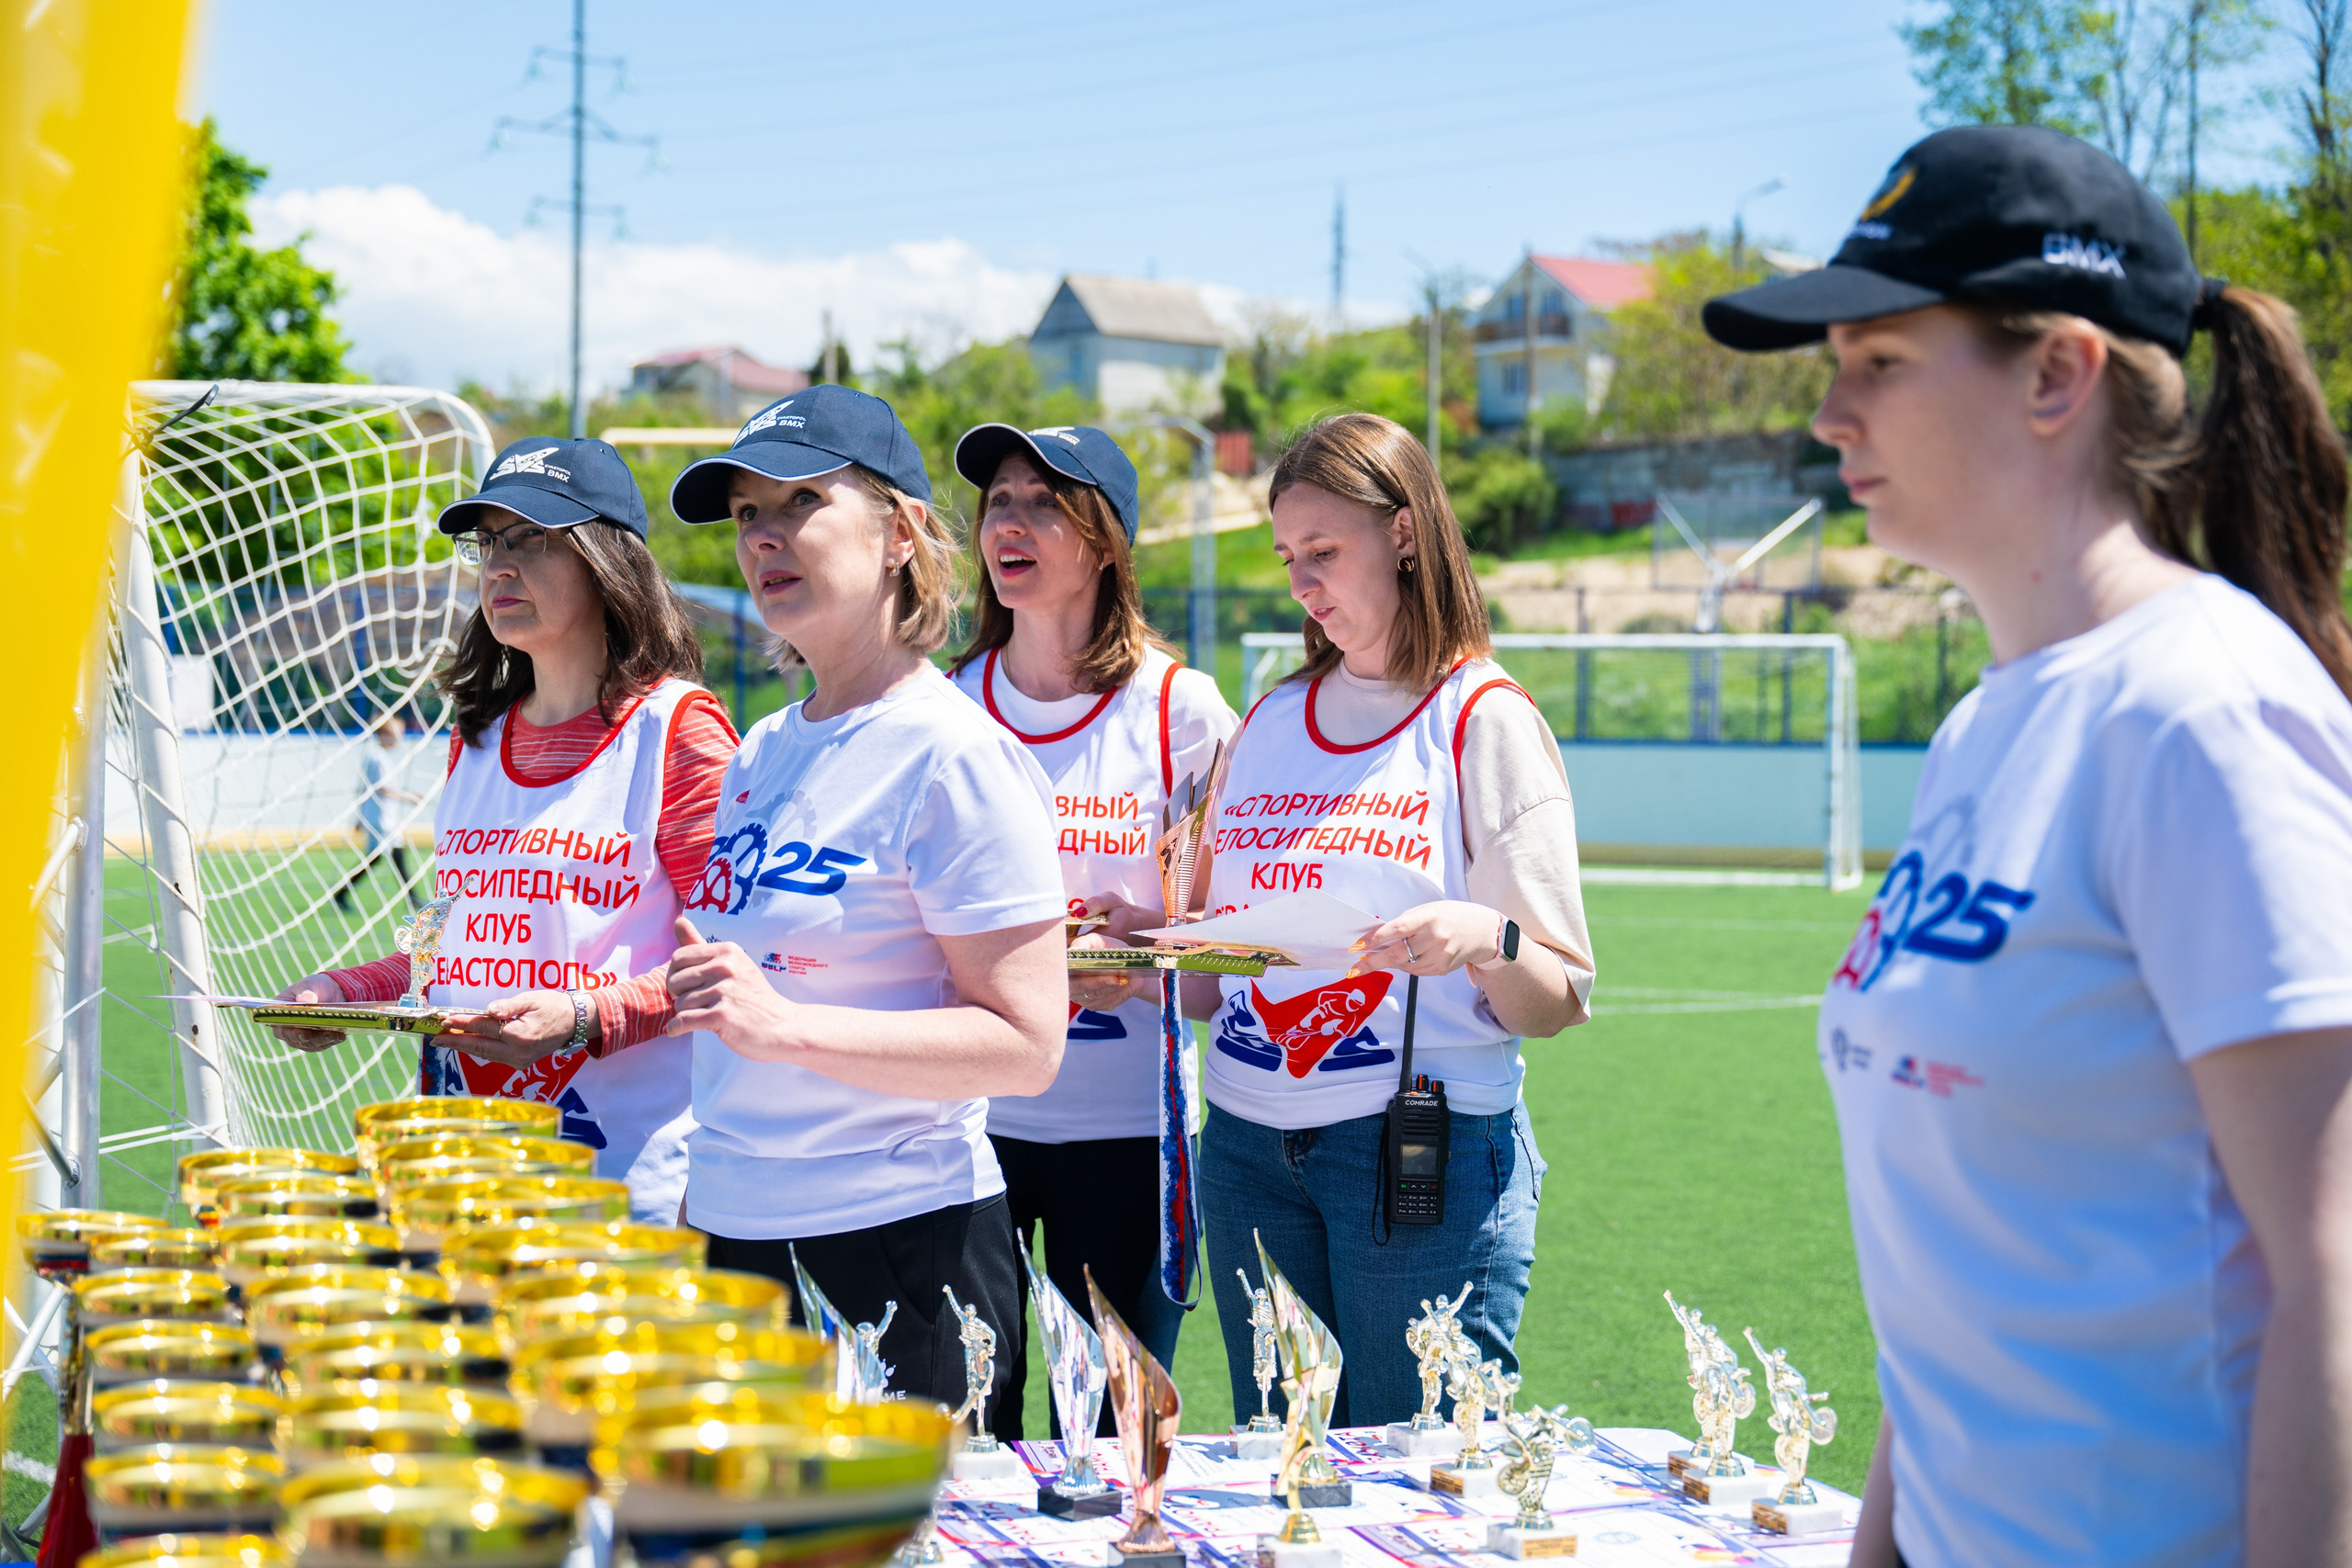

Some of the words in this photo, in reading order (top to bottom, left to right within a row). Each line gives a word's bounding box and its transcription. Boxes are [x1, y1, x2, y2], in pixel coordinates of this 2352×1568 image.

[2041, 233, 2127, 279] BMX
[779, 420, 805, 429] BMX
[548, 470, 570, 483] BMX
[1224, 790, 1430, 826] «СПОРТИВНЫЙ
[1214, 827, 1431, 871] ЕЛОСИПЕДНЫЙ
[435, 868, 640, 910] ЛОСИПЕДНЫЙ
[1250, 862, 1324, 893] КЛУБ
[465, 913, 532, 946] КЛУБ
